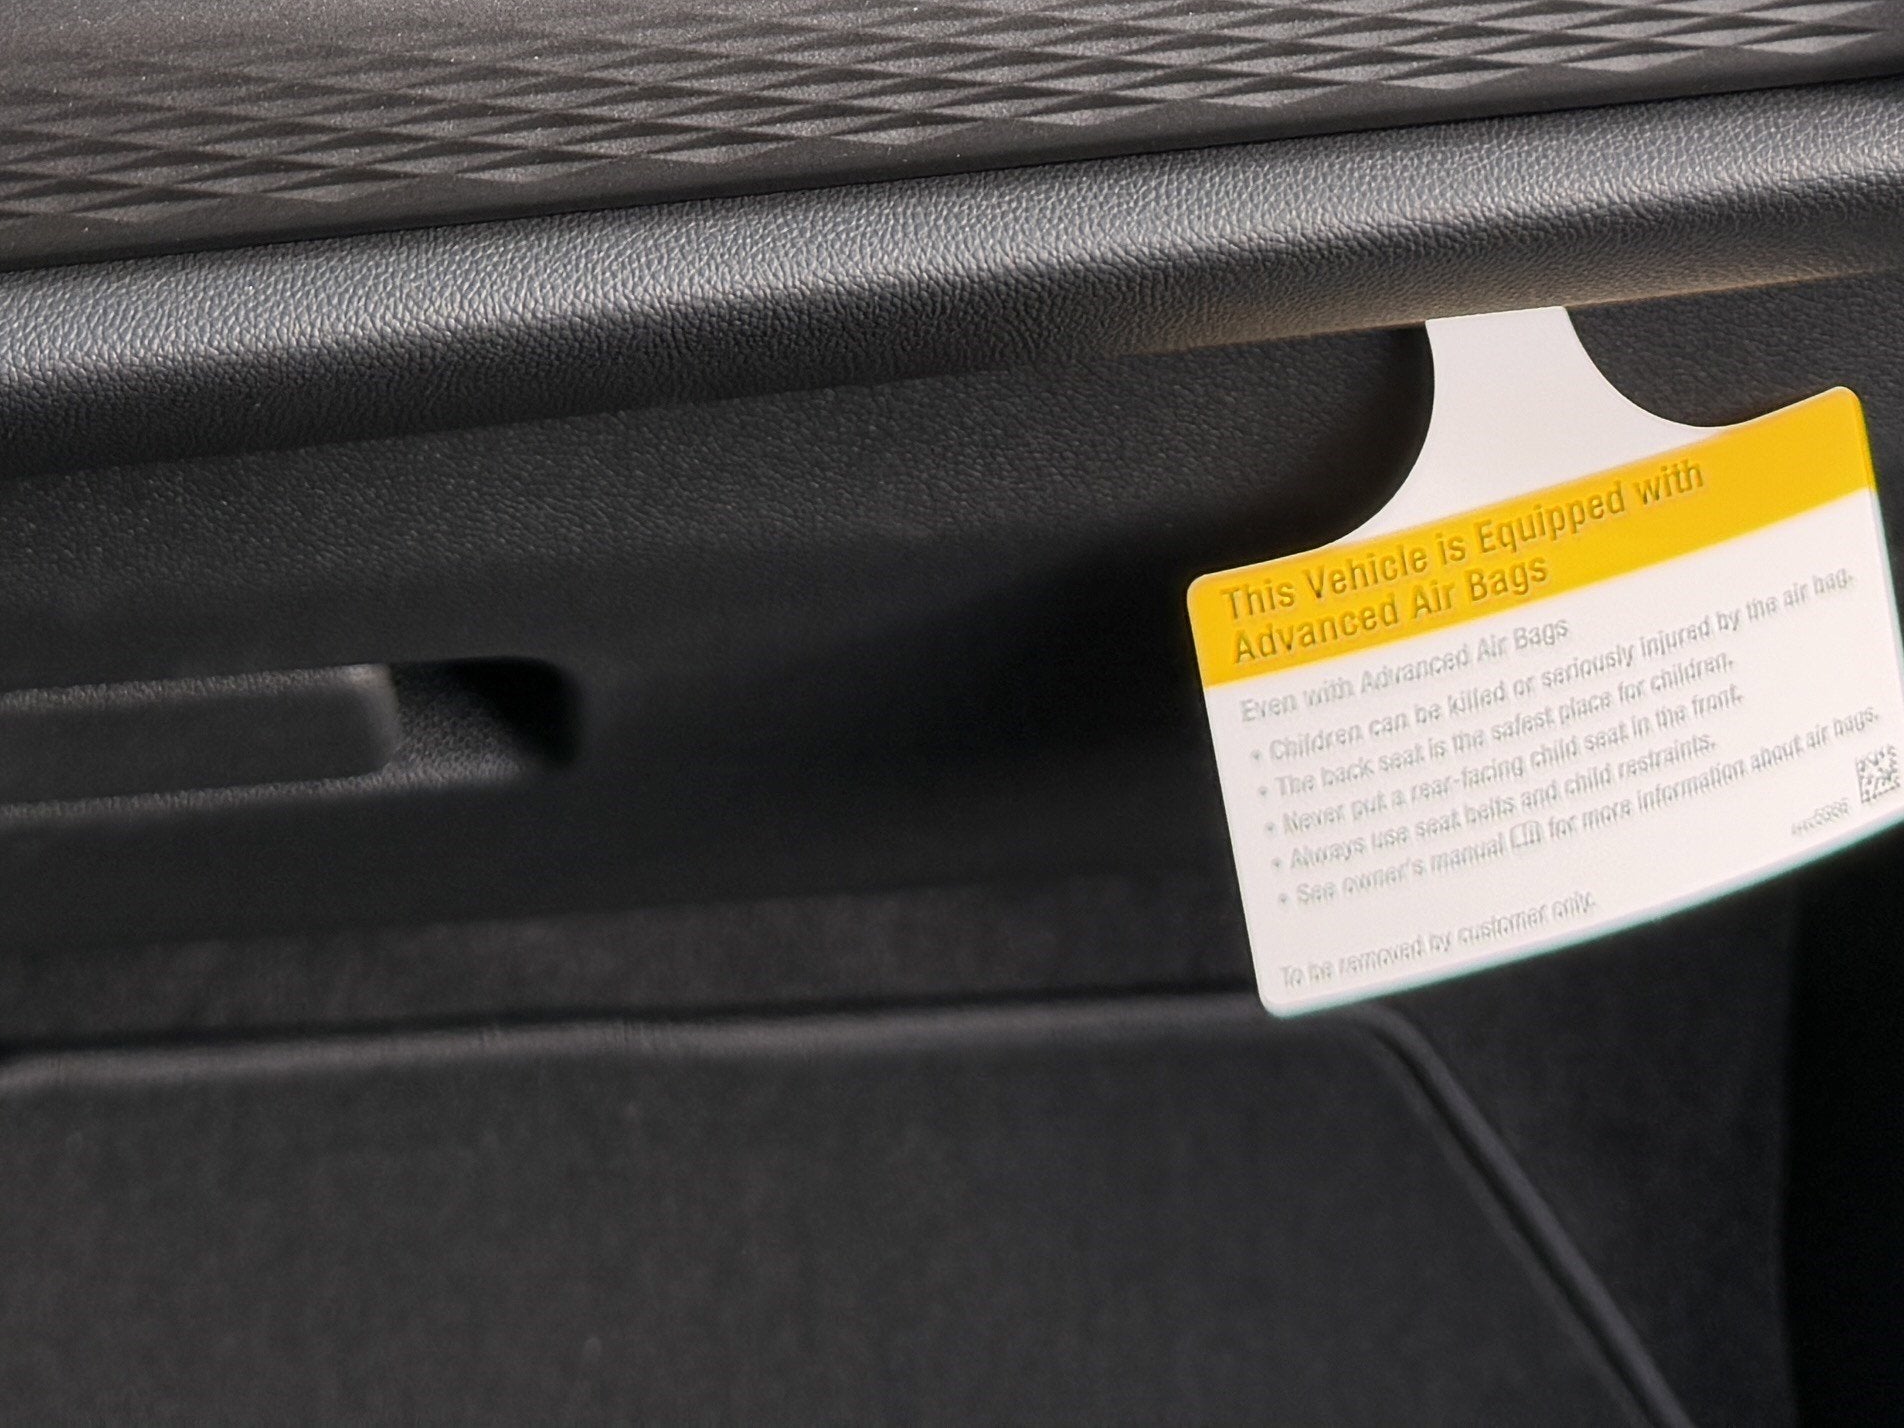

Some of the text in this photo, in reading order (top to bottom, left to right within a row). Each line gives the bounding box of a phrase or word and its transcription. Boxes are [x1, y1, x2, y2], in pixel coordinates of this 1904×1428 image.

[1221, 459, 1704, 621] This Vehicle is Equipped with
[1233, 555, 1548, 664] Advanced Air Bags
[1240, 619, 1568, 722] Even with Advanced Air Bags
[1269, 722, 1364, 760] Children
[1369, 713, 1410, 737] can
[1414, 700, 1441, 725] be
[1448, 682, 1505, 715] killed
[1513, 675, 1538, 697] or
[1541, 643, 1635, 689] seriously
[1640, 615, 1711, 658] injured
[1717, 608, 1741, 631] by
[1746, 596, 1778, 624] the
[1783, 582, 1808, 608] air
[1275, 651, 1733, 796] The back seat is the safest place for children.
[1283, 802, 1346, 835] Never
[1351, 793, 1387, 821] put
[1391, 788, 1405, 806] a
[1411, 756, 1524, 803] rear-facing
[1530, 732, 1577, 768] child
[1584, 721, 1629, 752] seat
[1632, 714, 1650, 737] in
[1656, 703, 1686, 730] the
[1291, 833, 1366, 870] Always
[1371, 826, 1407, 848] use
[1415, 811, 1462, 838] seat
[1465, 794, 1516, 825] belts
[1521, 780, 1557, 807] and
[1563, 763, 1612, 796] child
[1548, 815, 1576, 839] for
[1582, 800, 1633, 829] more
[1636, 763, 1747, 812] information
[1279, 964, 1306, 988] To
[1429, 931, 1452, 954] by
